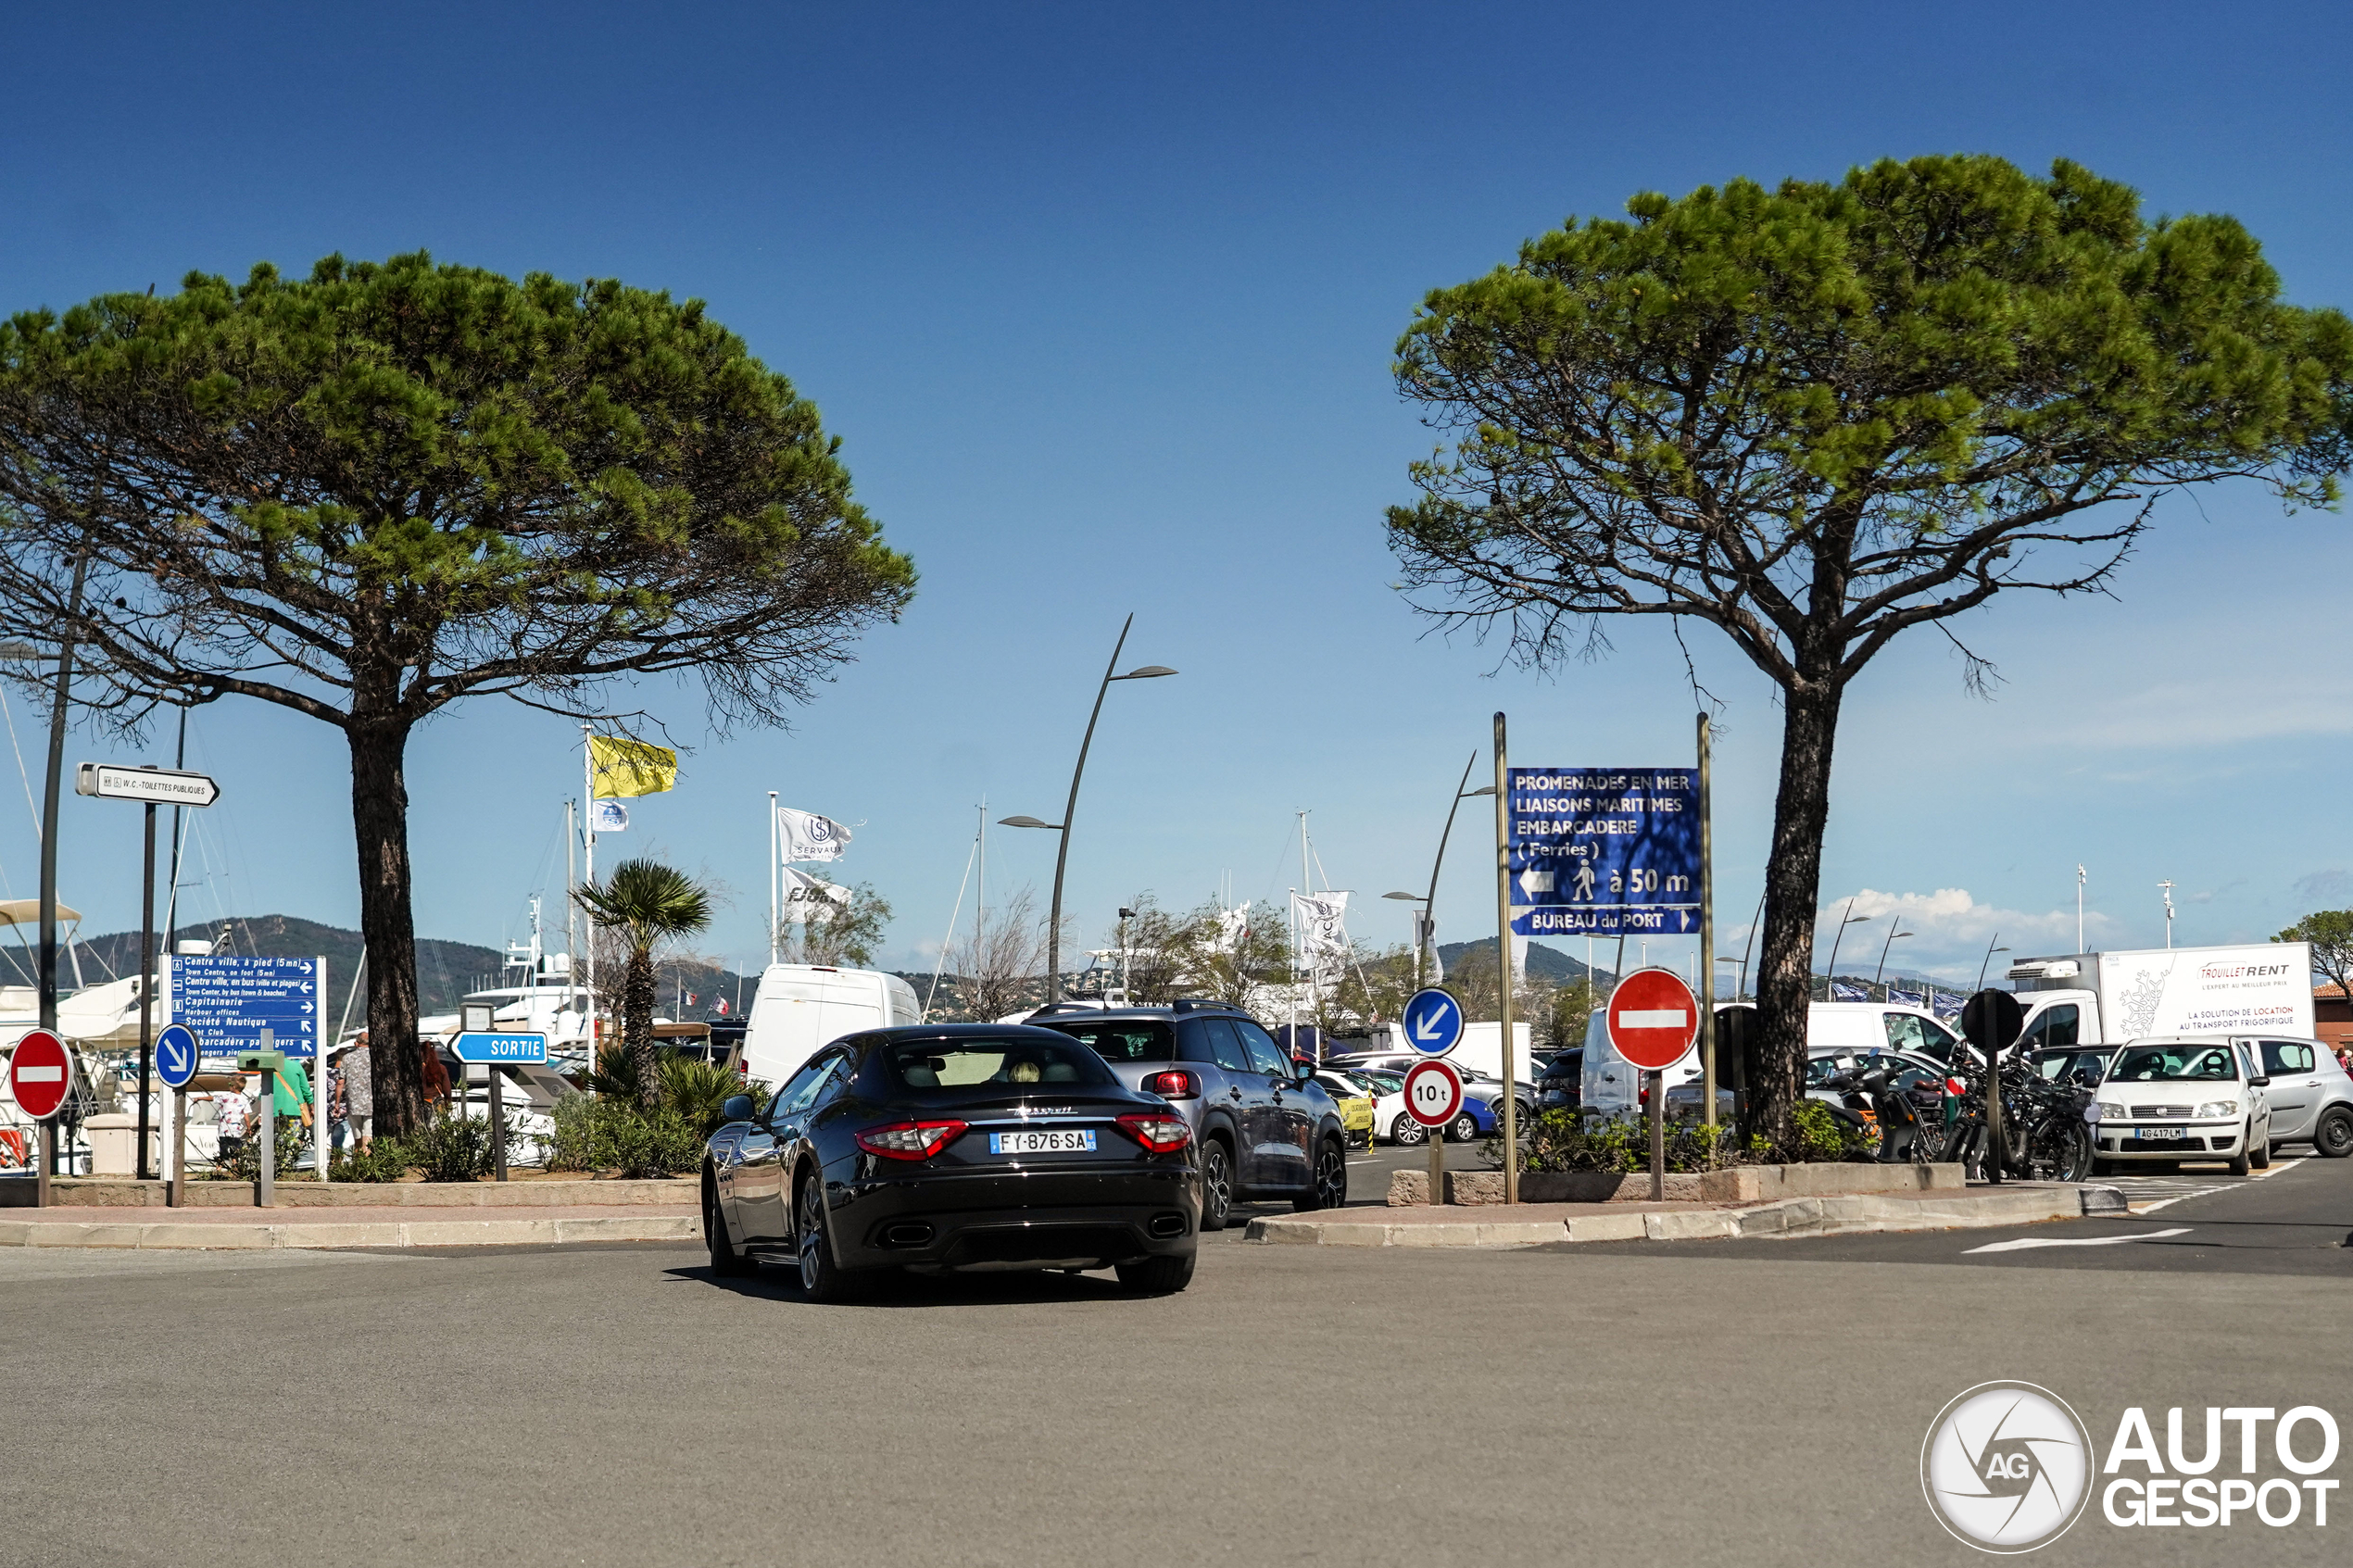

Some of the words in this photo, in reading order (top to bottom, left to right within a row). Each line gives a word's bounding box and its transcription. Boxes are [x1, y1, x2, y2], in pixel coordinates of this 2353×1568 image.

[173, 784, 206, 795] PUBLIQUES
[1516, 776, 1627, 790] PROMENADES
[1630, 776, 1653, 790] EN
[1656, 776, 1690, 790] MER
[1516, 798, 1592, 812] LIAISONS
[1596, 798, 1682, 812] MARITIMES
[1517, 821, 1637, 834] EMBARCADERE
[1609, 869, 1623, 893] à
[1630, 869, 1658, 893] 50
[1666, 874, 1689, 892] m
[1601, 914, 1618, 928] du
[1623, 913, 1664, 928] PORT
[185, 956, 213, 966] Centre
[219, 958, 240, 968] ville,
[245, 958, 249, 966] à
[254, 958, 272, 968] pied
[185, 976, 210, 986] Centre
[212, 977, 229, 987] ville,
[242, 977, 255, 986] bus
[256, 979, 270, 987] (ville
[279, 980, 301, 988] plages)
[185, 997, 243, 1008] Capitainerie
[2201, 1010, 2240, 1019] SOLUTION
[2253, 1006, 2294, 1016] LOCATION
[185, 1017, 220, 1026] Société
[226, 1017, 267, 1028] Nautique
[2193, 1020, 2238, 1030] TRANSPORT
[2240, 1016, 2294, 1026] FRIGORIFIQUE
[199, 1037, 245, 1046] barcadère
[249, 1038, 295, 1047] pagers
[491, 1040, 540, 1056] SORTIE
[1000, 1133, 1086, 1150] FY-876-SA
